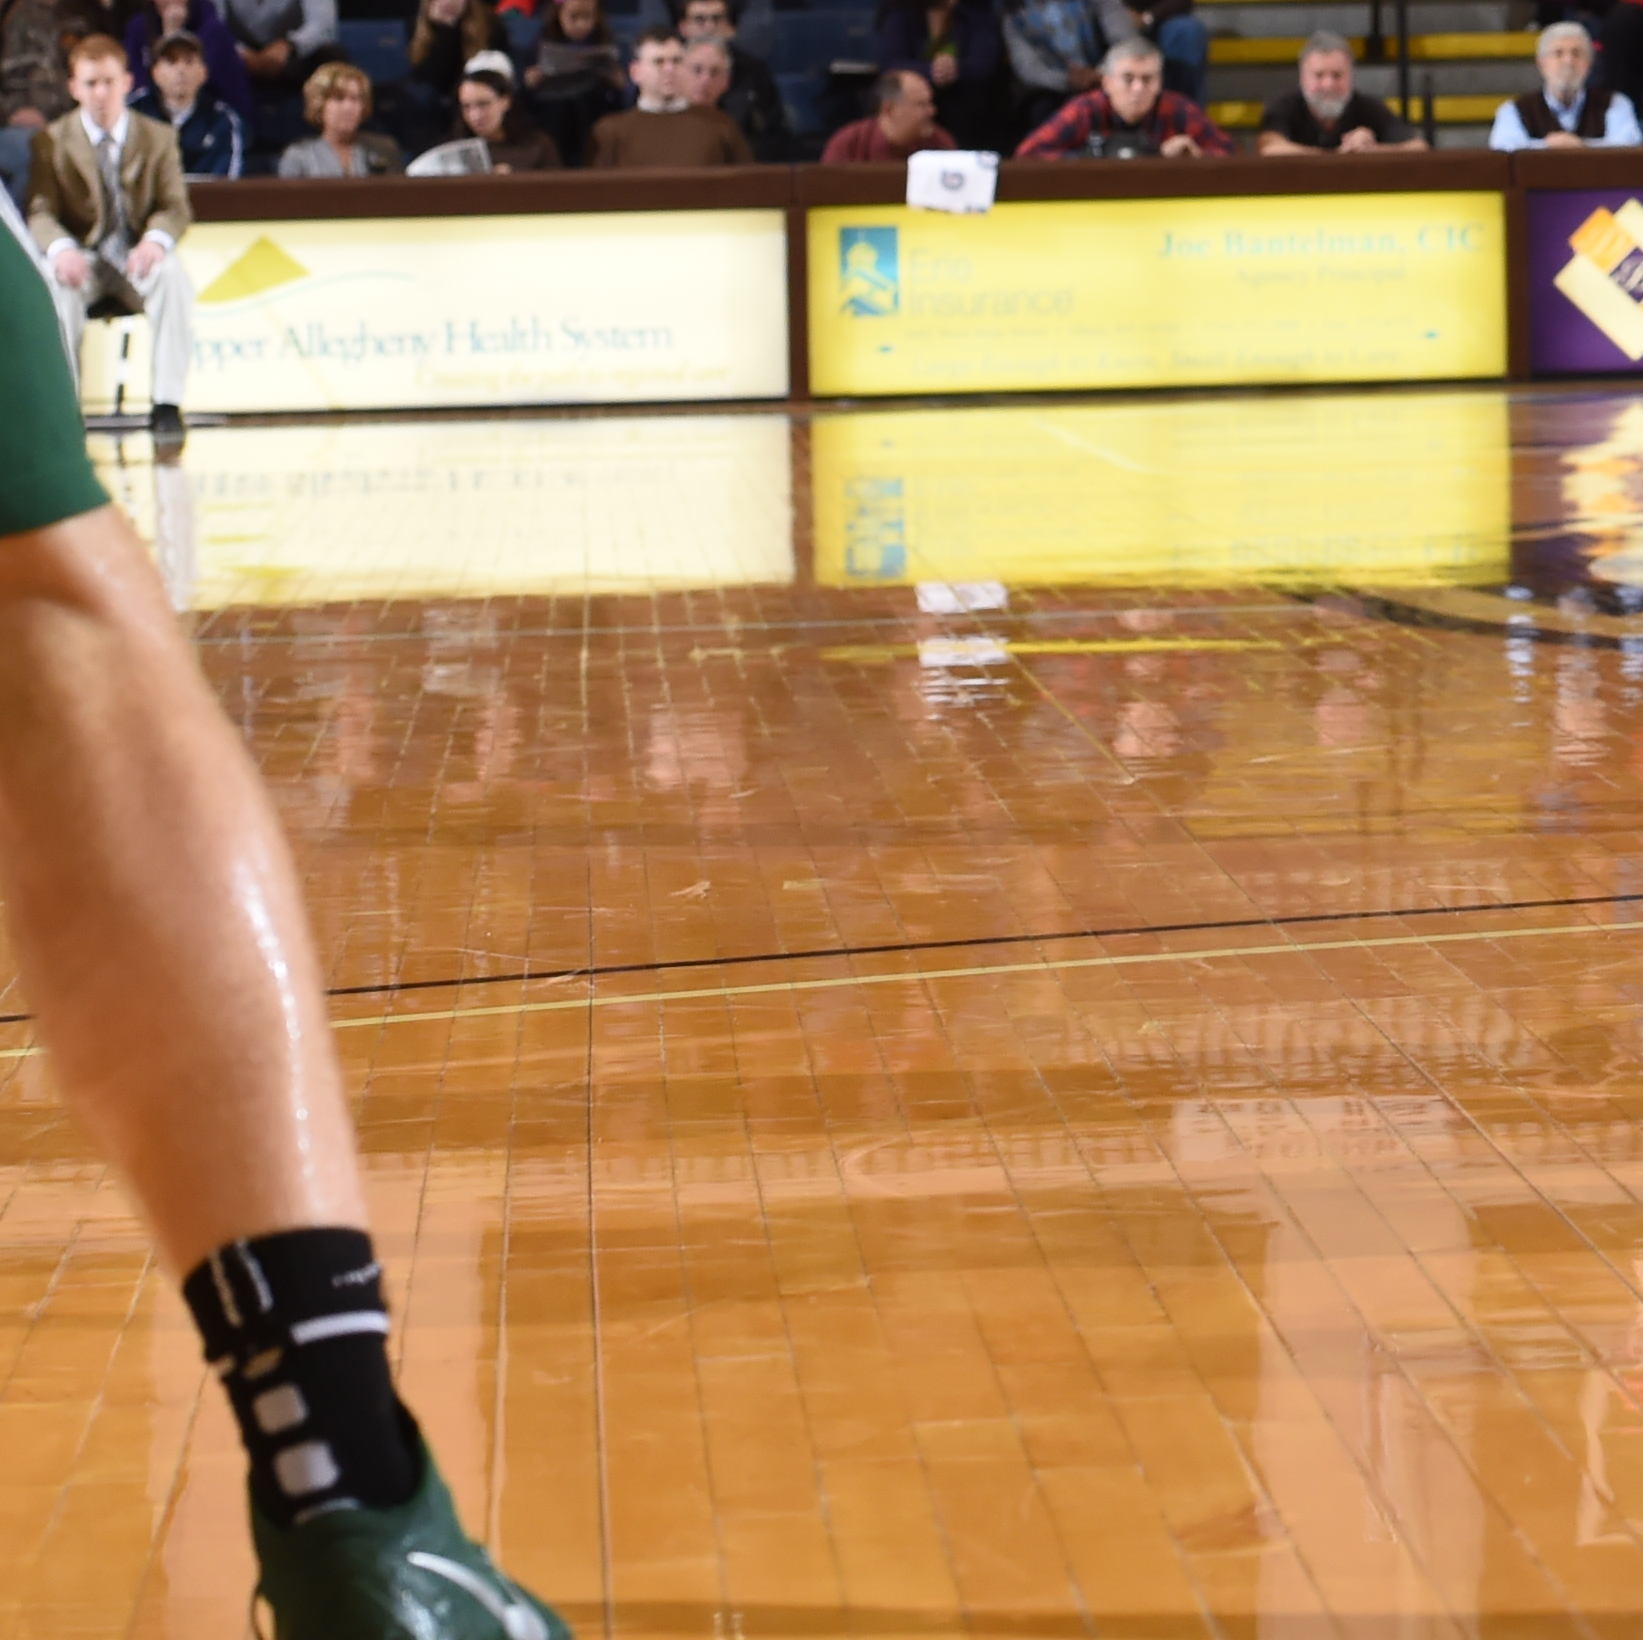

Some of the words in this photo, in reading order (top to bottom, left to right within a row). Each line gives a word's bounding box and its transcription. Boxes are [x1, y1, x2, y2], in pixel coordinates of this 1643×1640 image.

[1156, 230, 1213, 259] Joe
[1417, 224, 1487, 254] CIC
[907, 287, 1077, 318] Insurance
[184, 335, 268, 373] pper
[279, 320, 432, 368] Allegheny
[444, 314, 552, 354] Health
[560, 316, 674, 362] System
